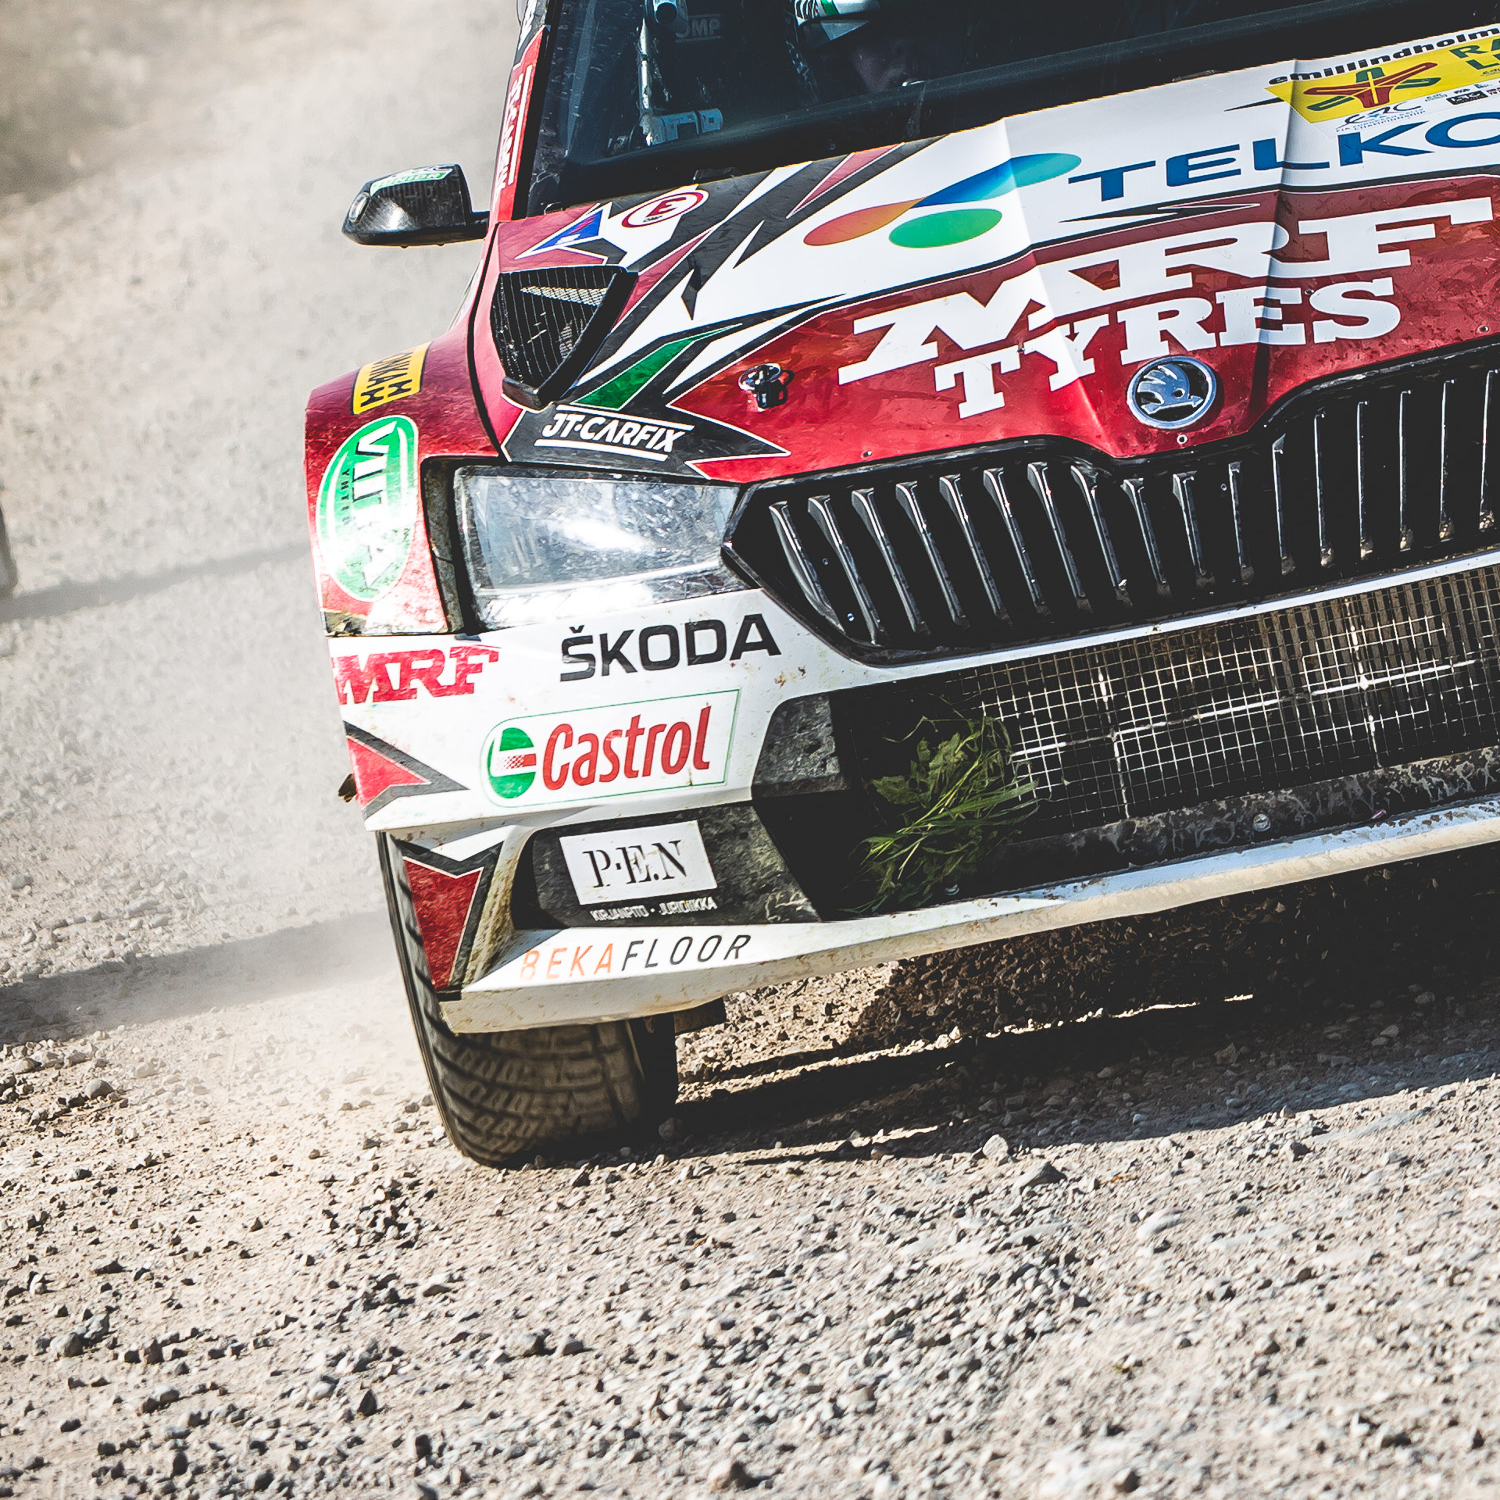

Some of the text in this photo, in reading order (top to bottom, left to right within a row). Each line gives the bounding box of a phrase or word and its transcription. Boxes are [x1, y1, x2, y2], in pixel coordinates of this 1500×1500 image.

[837, 196, 1493, 386] MRF
[934, 277, 1402, 419] TYRES
[332, 644, 502, 705] MRF
[560, 612, 783, 683] ŠKODA
[541, 704, 713, 792] Castrol
[519, 933, 752, 982] BEKAFLOOR
